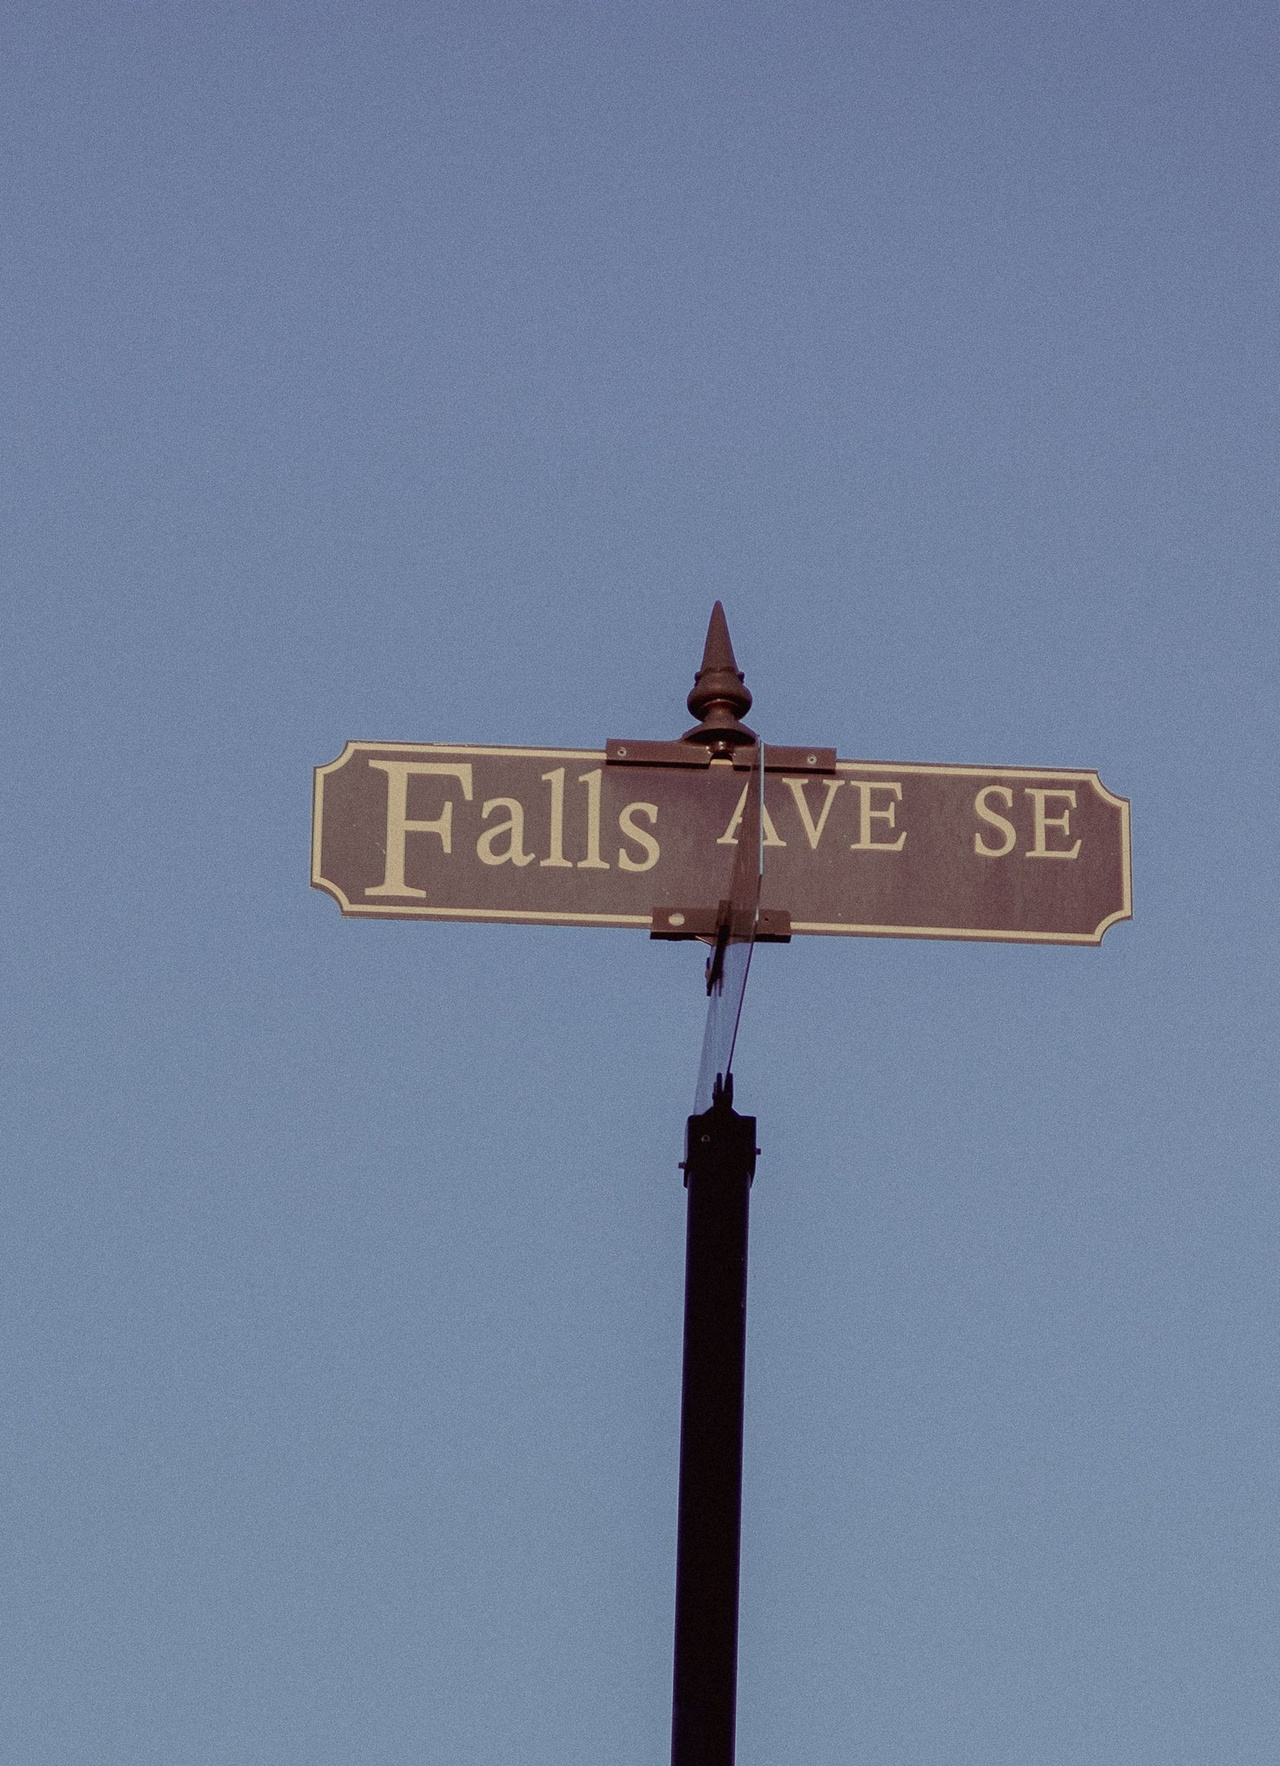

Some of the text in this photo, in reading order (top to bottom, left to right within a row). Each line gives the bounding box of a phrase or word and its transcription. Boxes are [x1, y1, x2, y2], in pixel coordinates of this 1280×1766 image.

[364, 759, 1082, 898] Falls AVE SE
